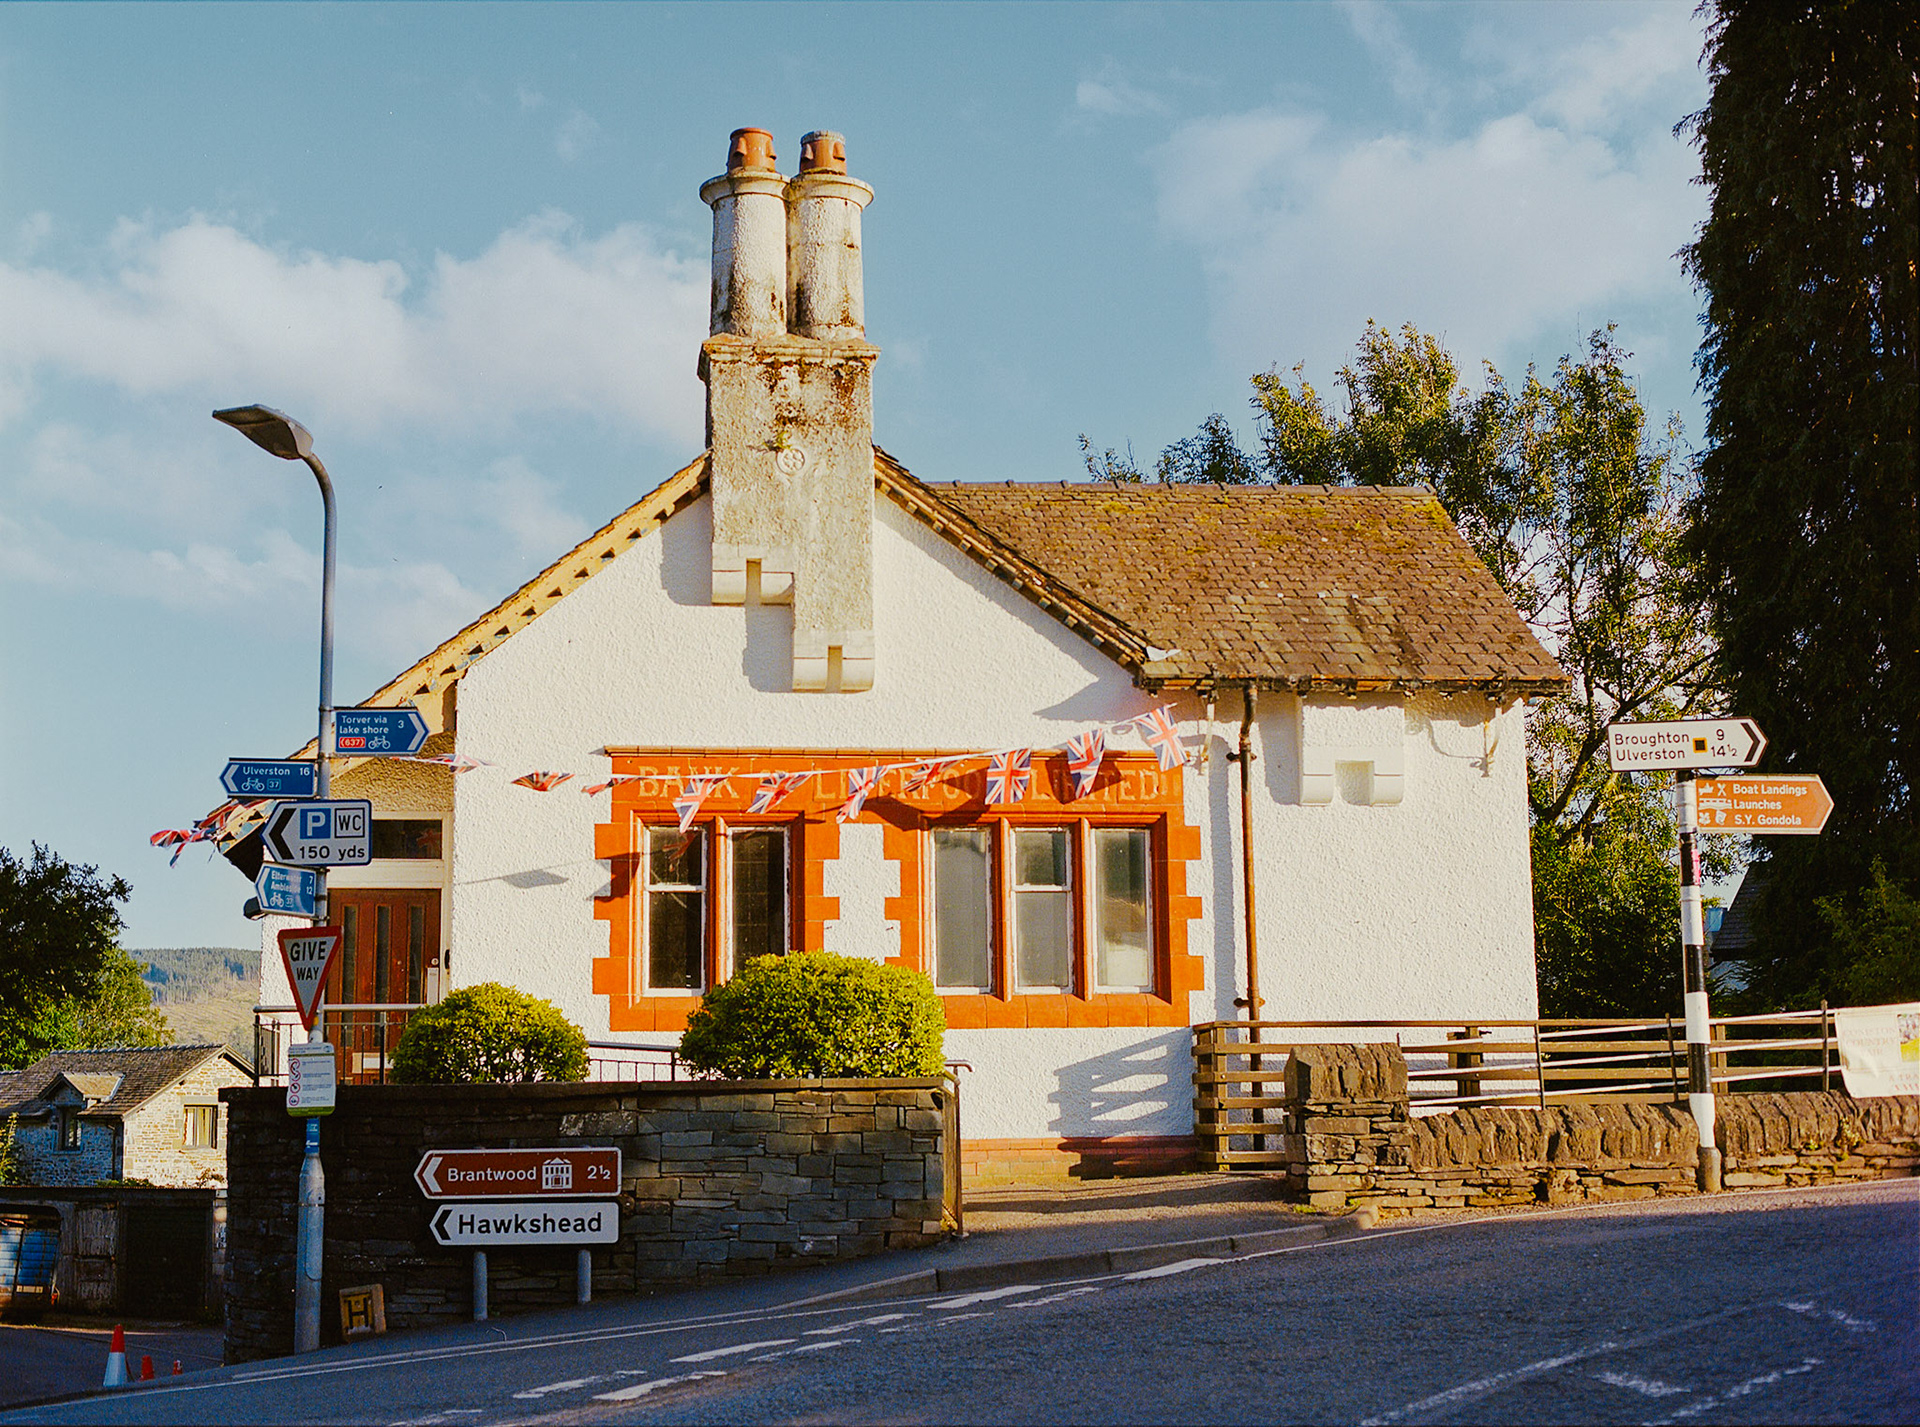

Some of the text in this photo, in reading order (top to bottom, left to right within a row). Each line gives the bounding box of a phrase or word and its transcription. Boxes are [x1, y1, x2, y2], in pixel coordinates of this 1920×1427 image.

[341, 715, 404, 729] Torver via 3
[362, 726, 389, 734] shore
[1614, 729, 1725, 747] Broughton 9
[1616, 749, 1685, 761] Ulverston
[242, 766, 310, 776] Ulverston 16
[268, 781, 280, 789] 37
[1733, 783, 1807, 796] Boat Landings
[1733, 799, 1782, 810] Launches
[306, 811, 362, 837] P WC
[1734, 814, 1801, 825] S.Y. Gondola
[299, 845, 365, 861] 150 yds
[308, 875, 314, 885] 7
[306, 886, 313, 895] 12
[290, 940, 327, 962] GIVE
[296, 967, 319, 981] WAY
[447, 1166, 537, 1182] Brantwood
[458, 1211, 602, 1235] Hawkshead
[347, 1297, 369, 1329] H
